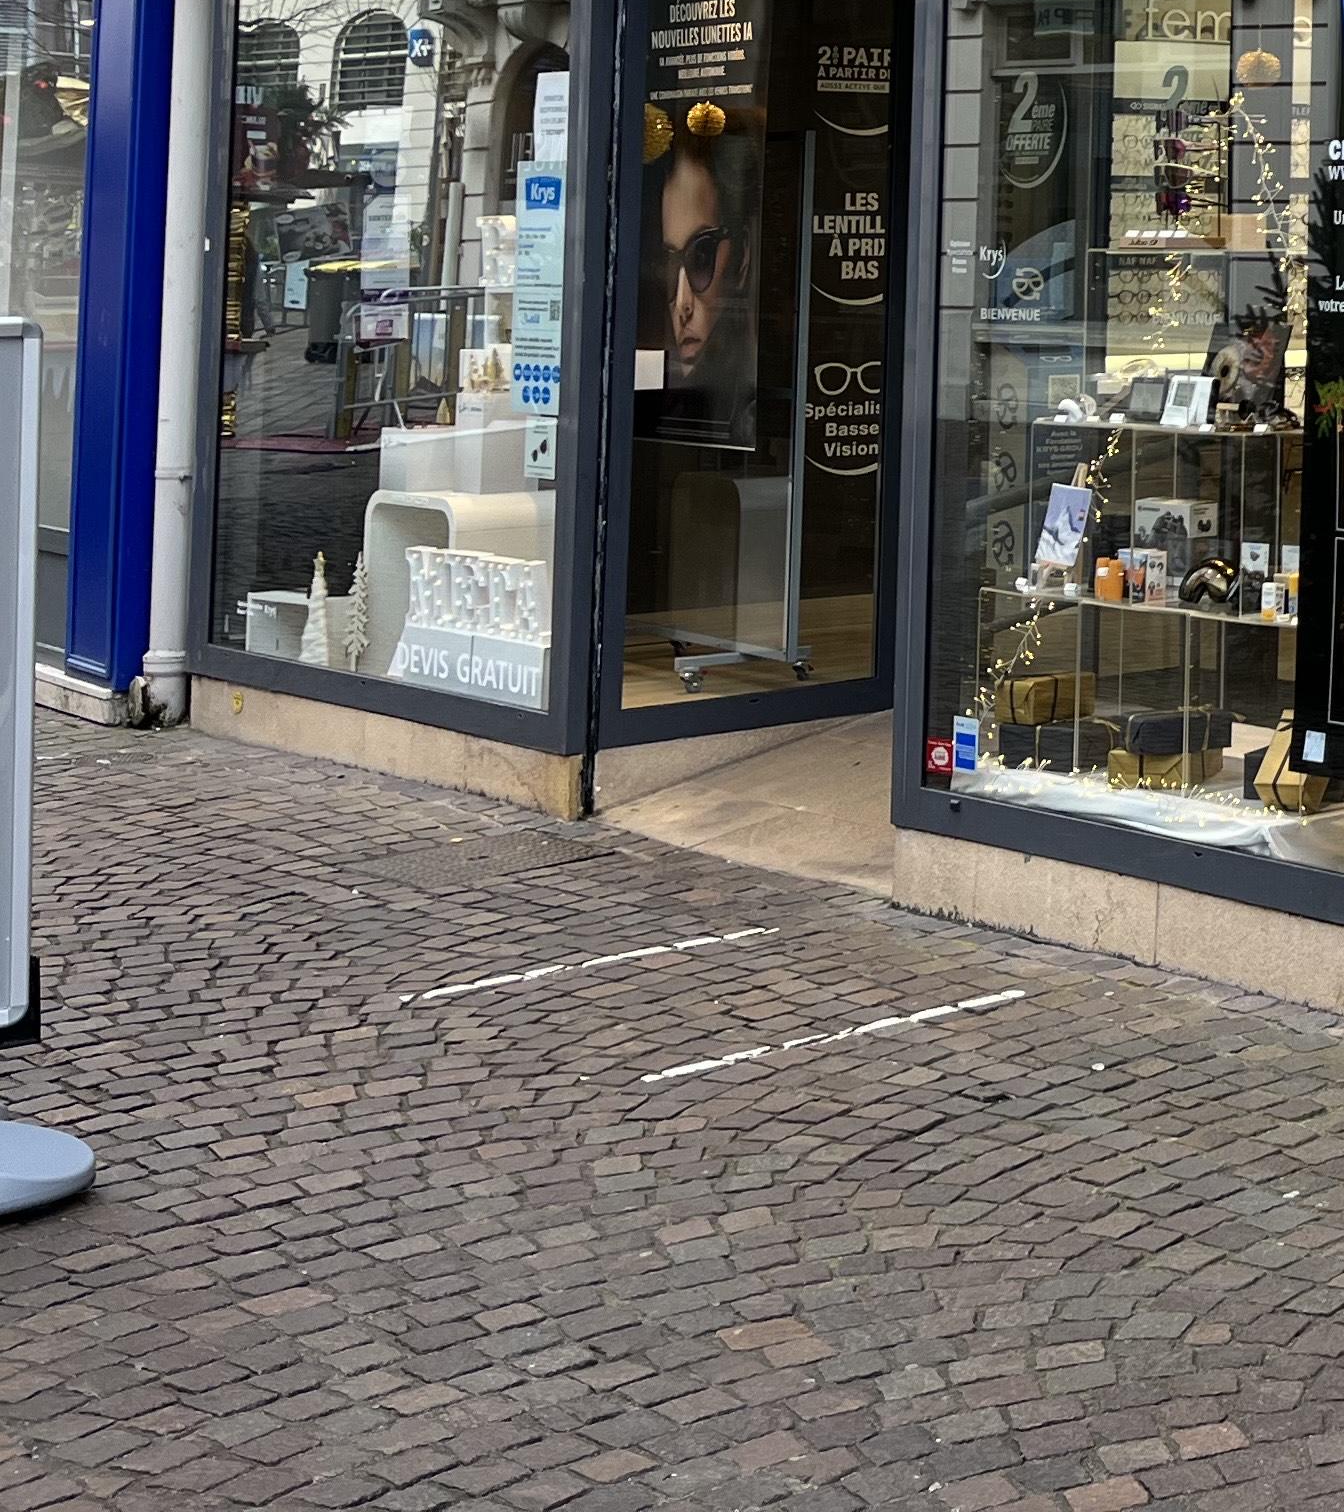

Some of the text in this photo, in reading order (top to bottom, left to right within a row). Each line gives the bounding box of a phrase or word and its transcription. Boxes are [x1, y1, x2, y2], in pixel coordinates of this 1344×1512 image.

[651, 21, 754, 49] NOUVELLES LUNETTES IA
[829, 66, 877, 79] PARTIR
[1005, 132, 1054, 152] OFFERTE
[530, 182, 556, 205] Krys
[844, 192, 879, 212] LES
[812, 214, 887, 234] LENTILL
[828, 233, 843, 257] À
[979, 244, 1004, 267] Krys
[1119, 256, 1158, 266] NAF NAF
[841, 260, 880, 281] BAS
[980, 308, 1041, 322] BIENVENUE
[824, 422, 880, 438] Basse
[823, 440, 880, 458] Vision
[397, 641, 542, 698] DEVIS GRATUIT
